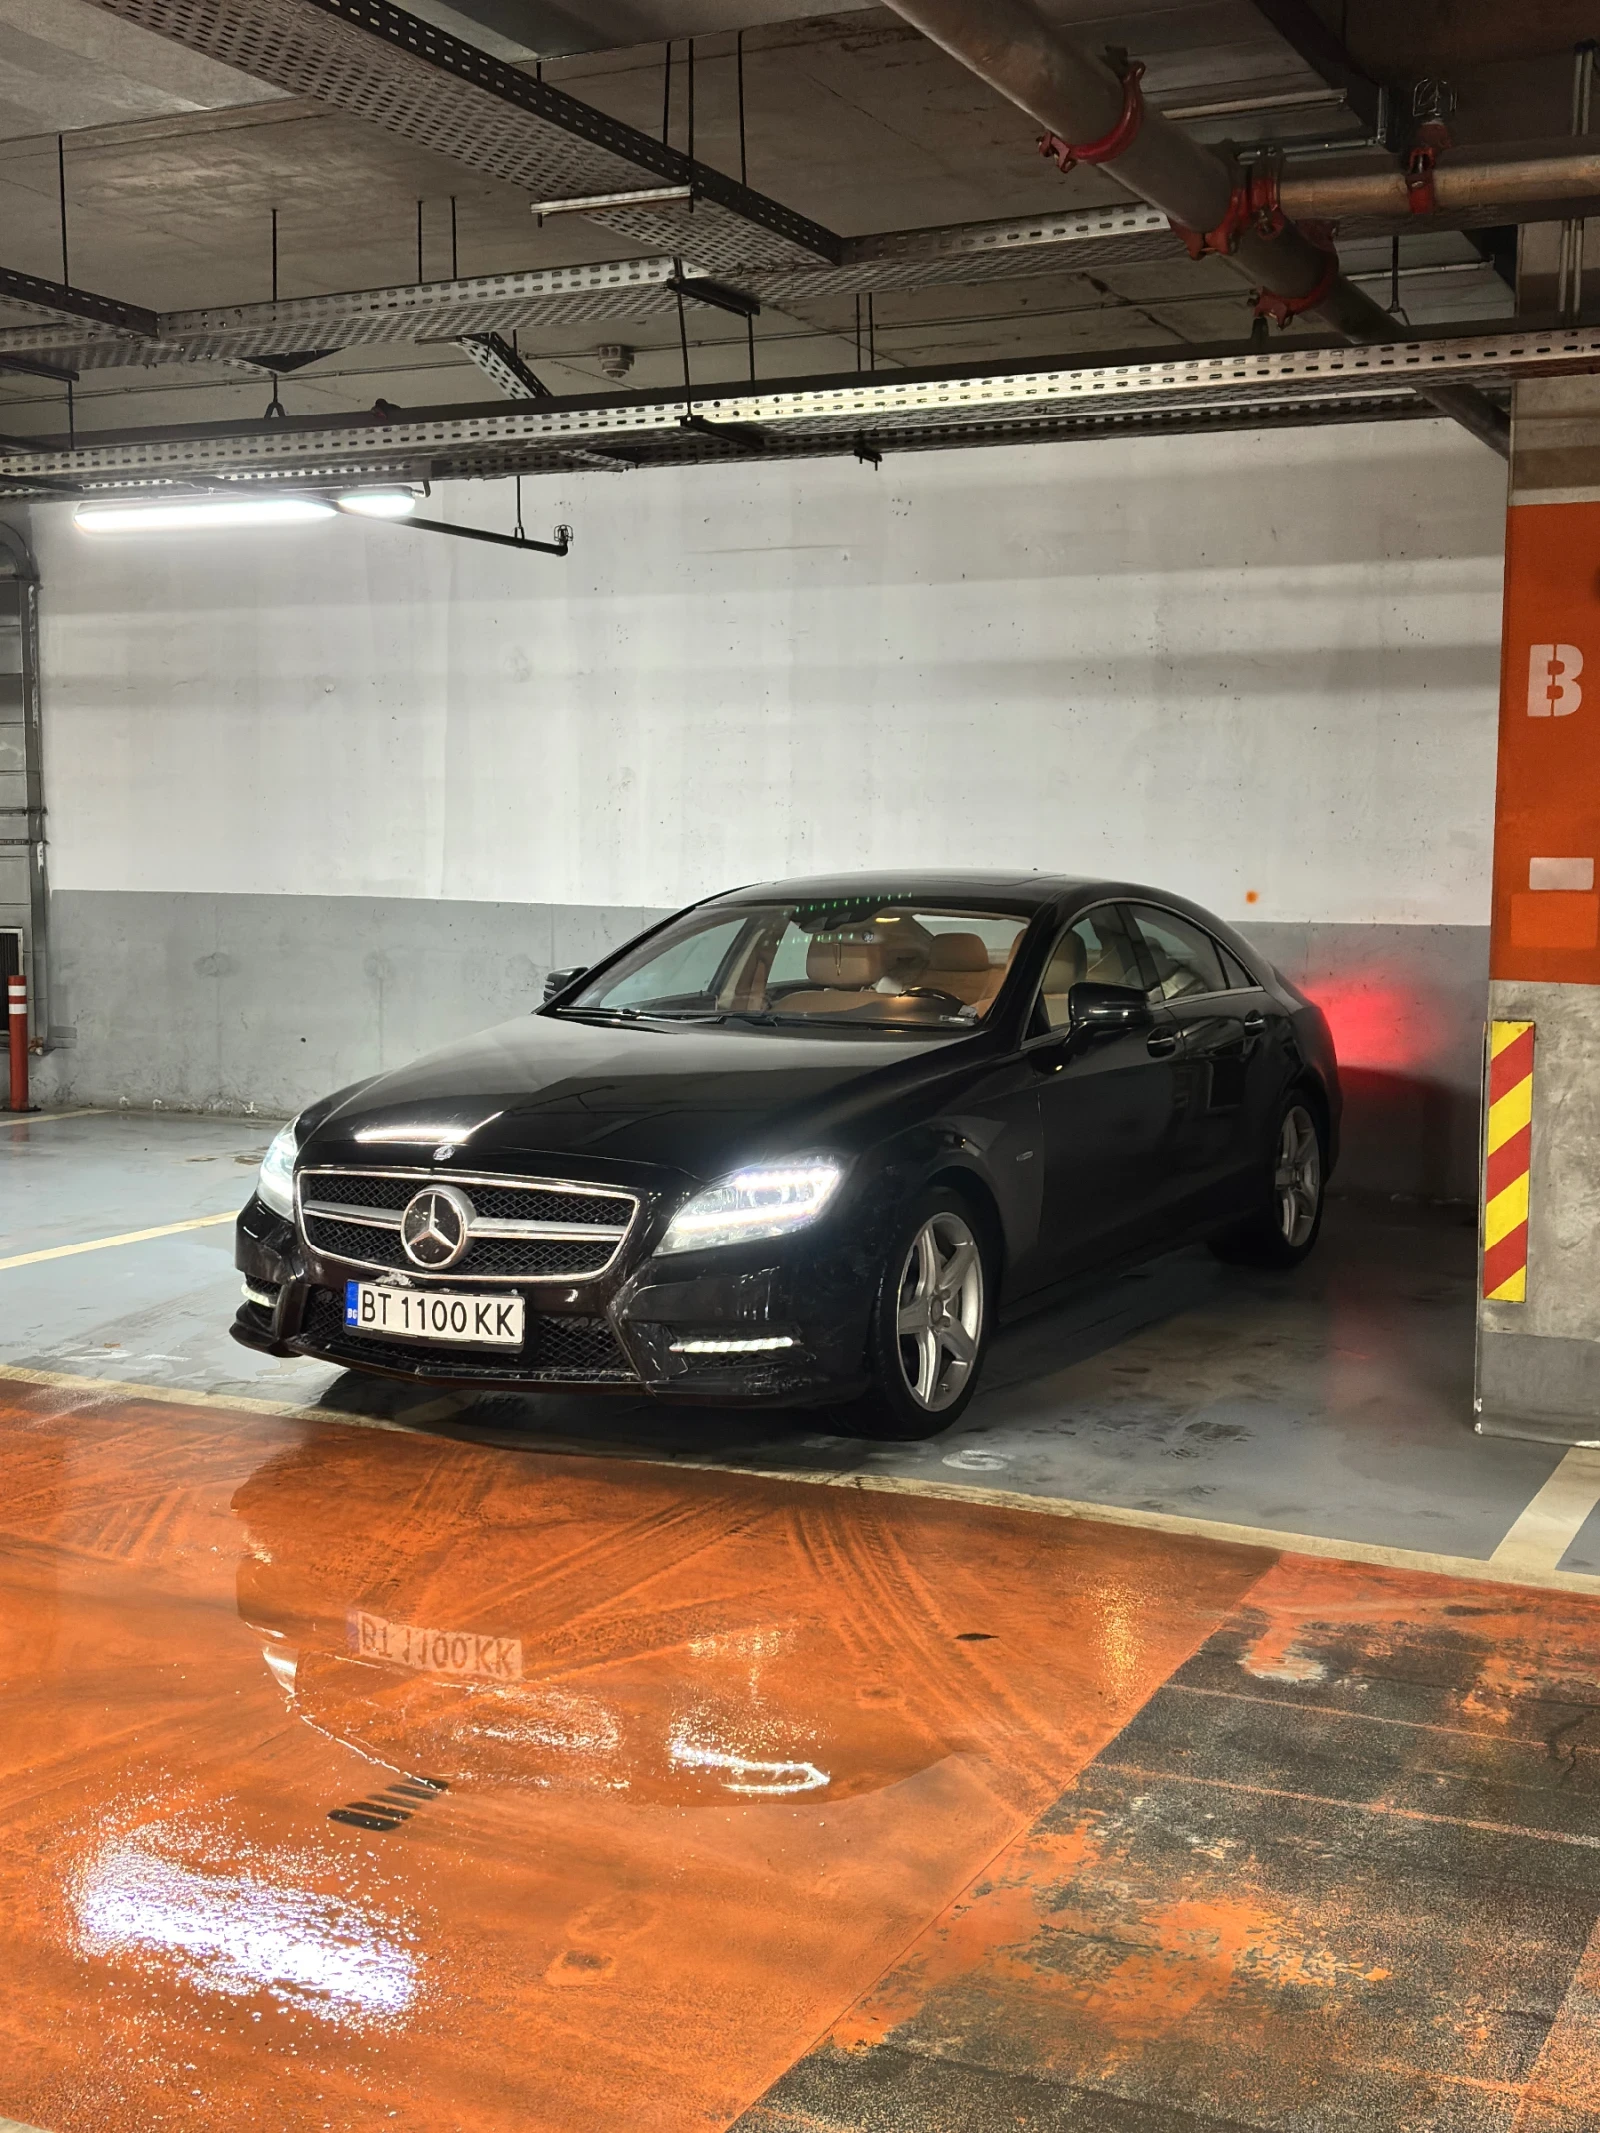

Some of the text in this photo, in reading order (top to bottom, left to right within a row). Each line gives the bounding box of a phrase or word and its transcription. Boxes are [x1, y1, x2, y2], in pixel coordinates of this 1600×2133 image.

[1527, 644, 1584, 717] B
[362, 1290, 515, 1337] BT 1100 KK
